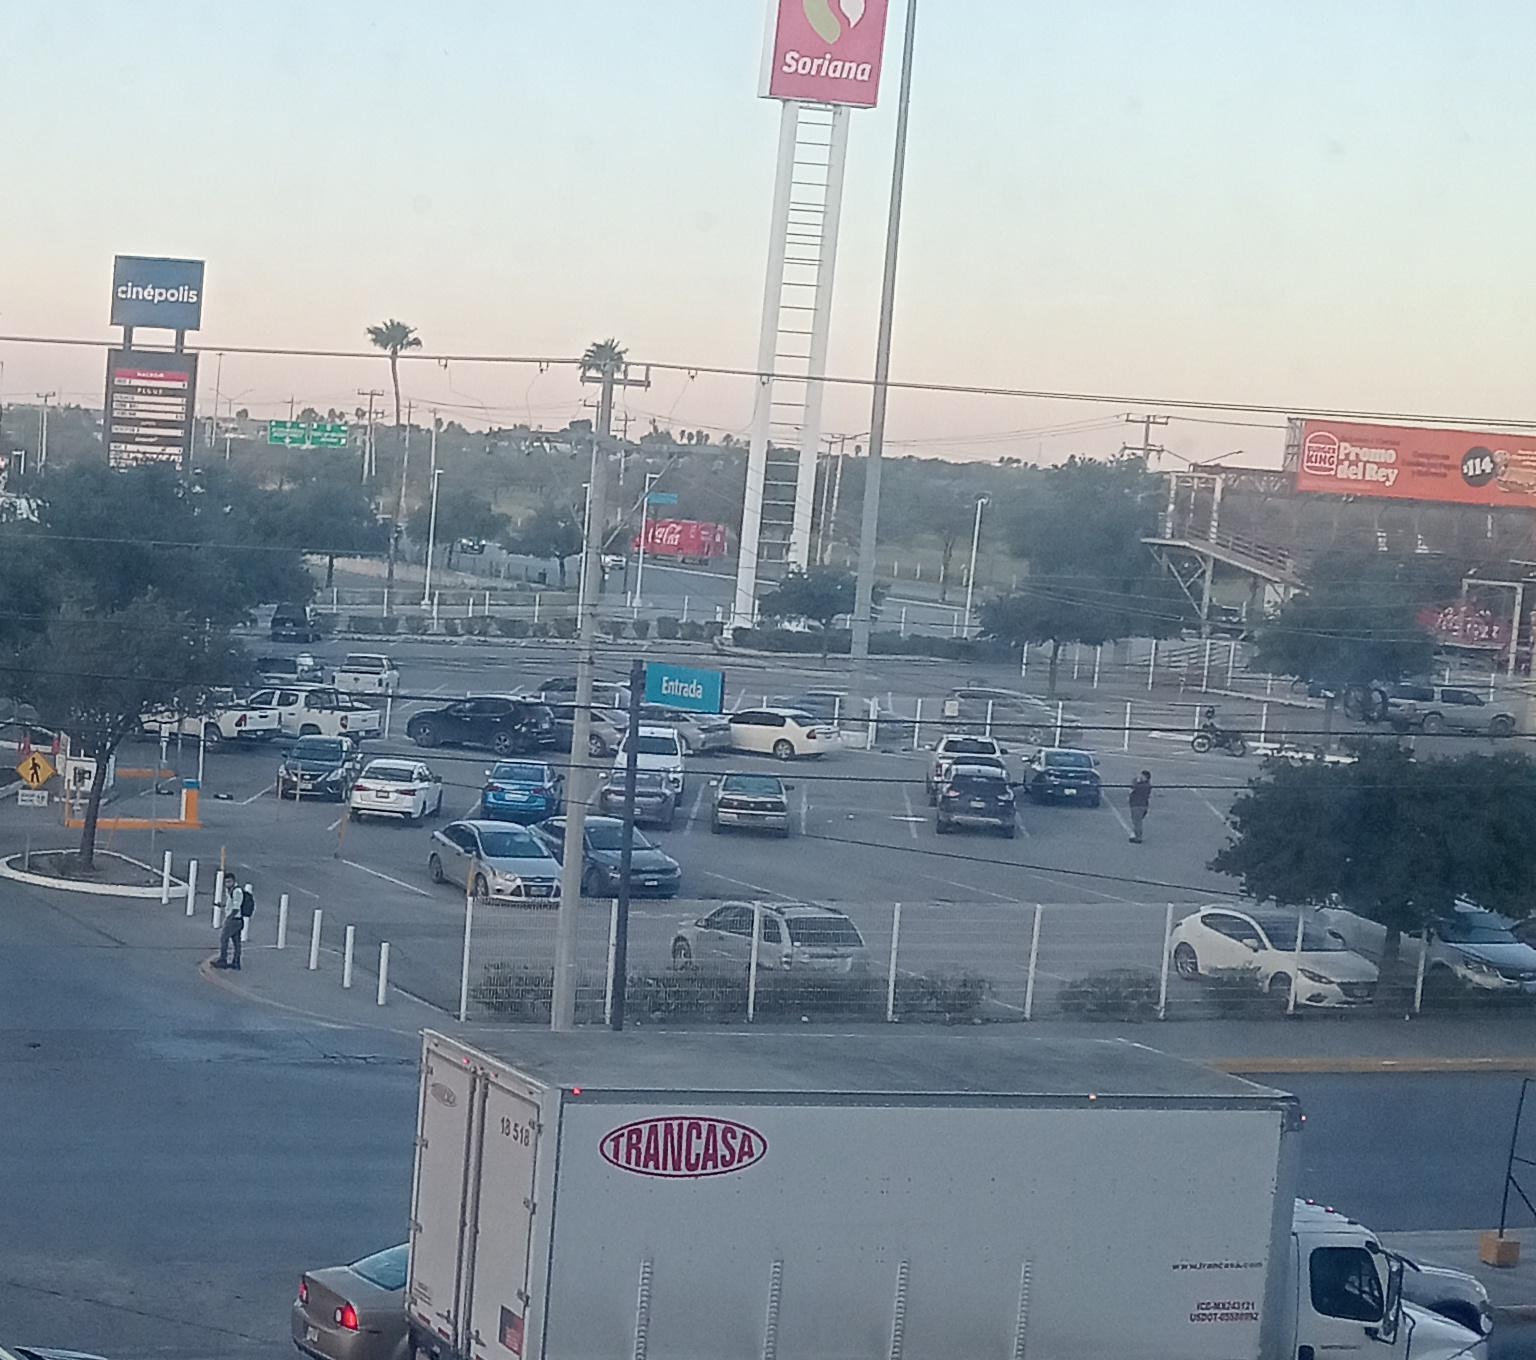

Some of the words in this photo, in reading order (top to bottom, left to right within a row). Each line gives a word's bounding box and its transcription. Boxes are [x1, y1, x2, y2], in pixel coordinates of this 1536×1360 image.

[782, 51, 871, 81] Soriana
[117, 282, 198, 304] cinépolis
[1306, 453, 1335, 466] KING
[1339, 442, 1396, 463] Promo
[1337, 461, 1364, 479] del
[1365, 463, 1398, 486] Rey
[661, 677, 703, 699] Entrada
[610, 1121, 754, 1171] TRANCASA
